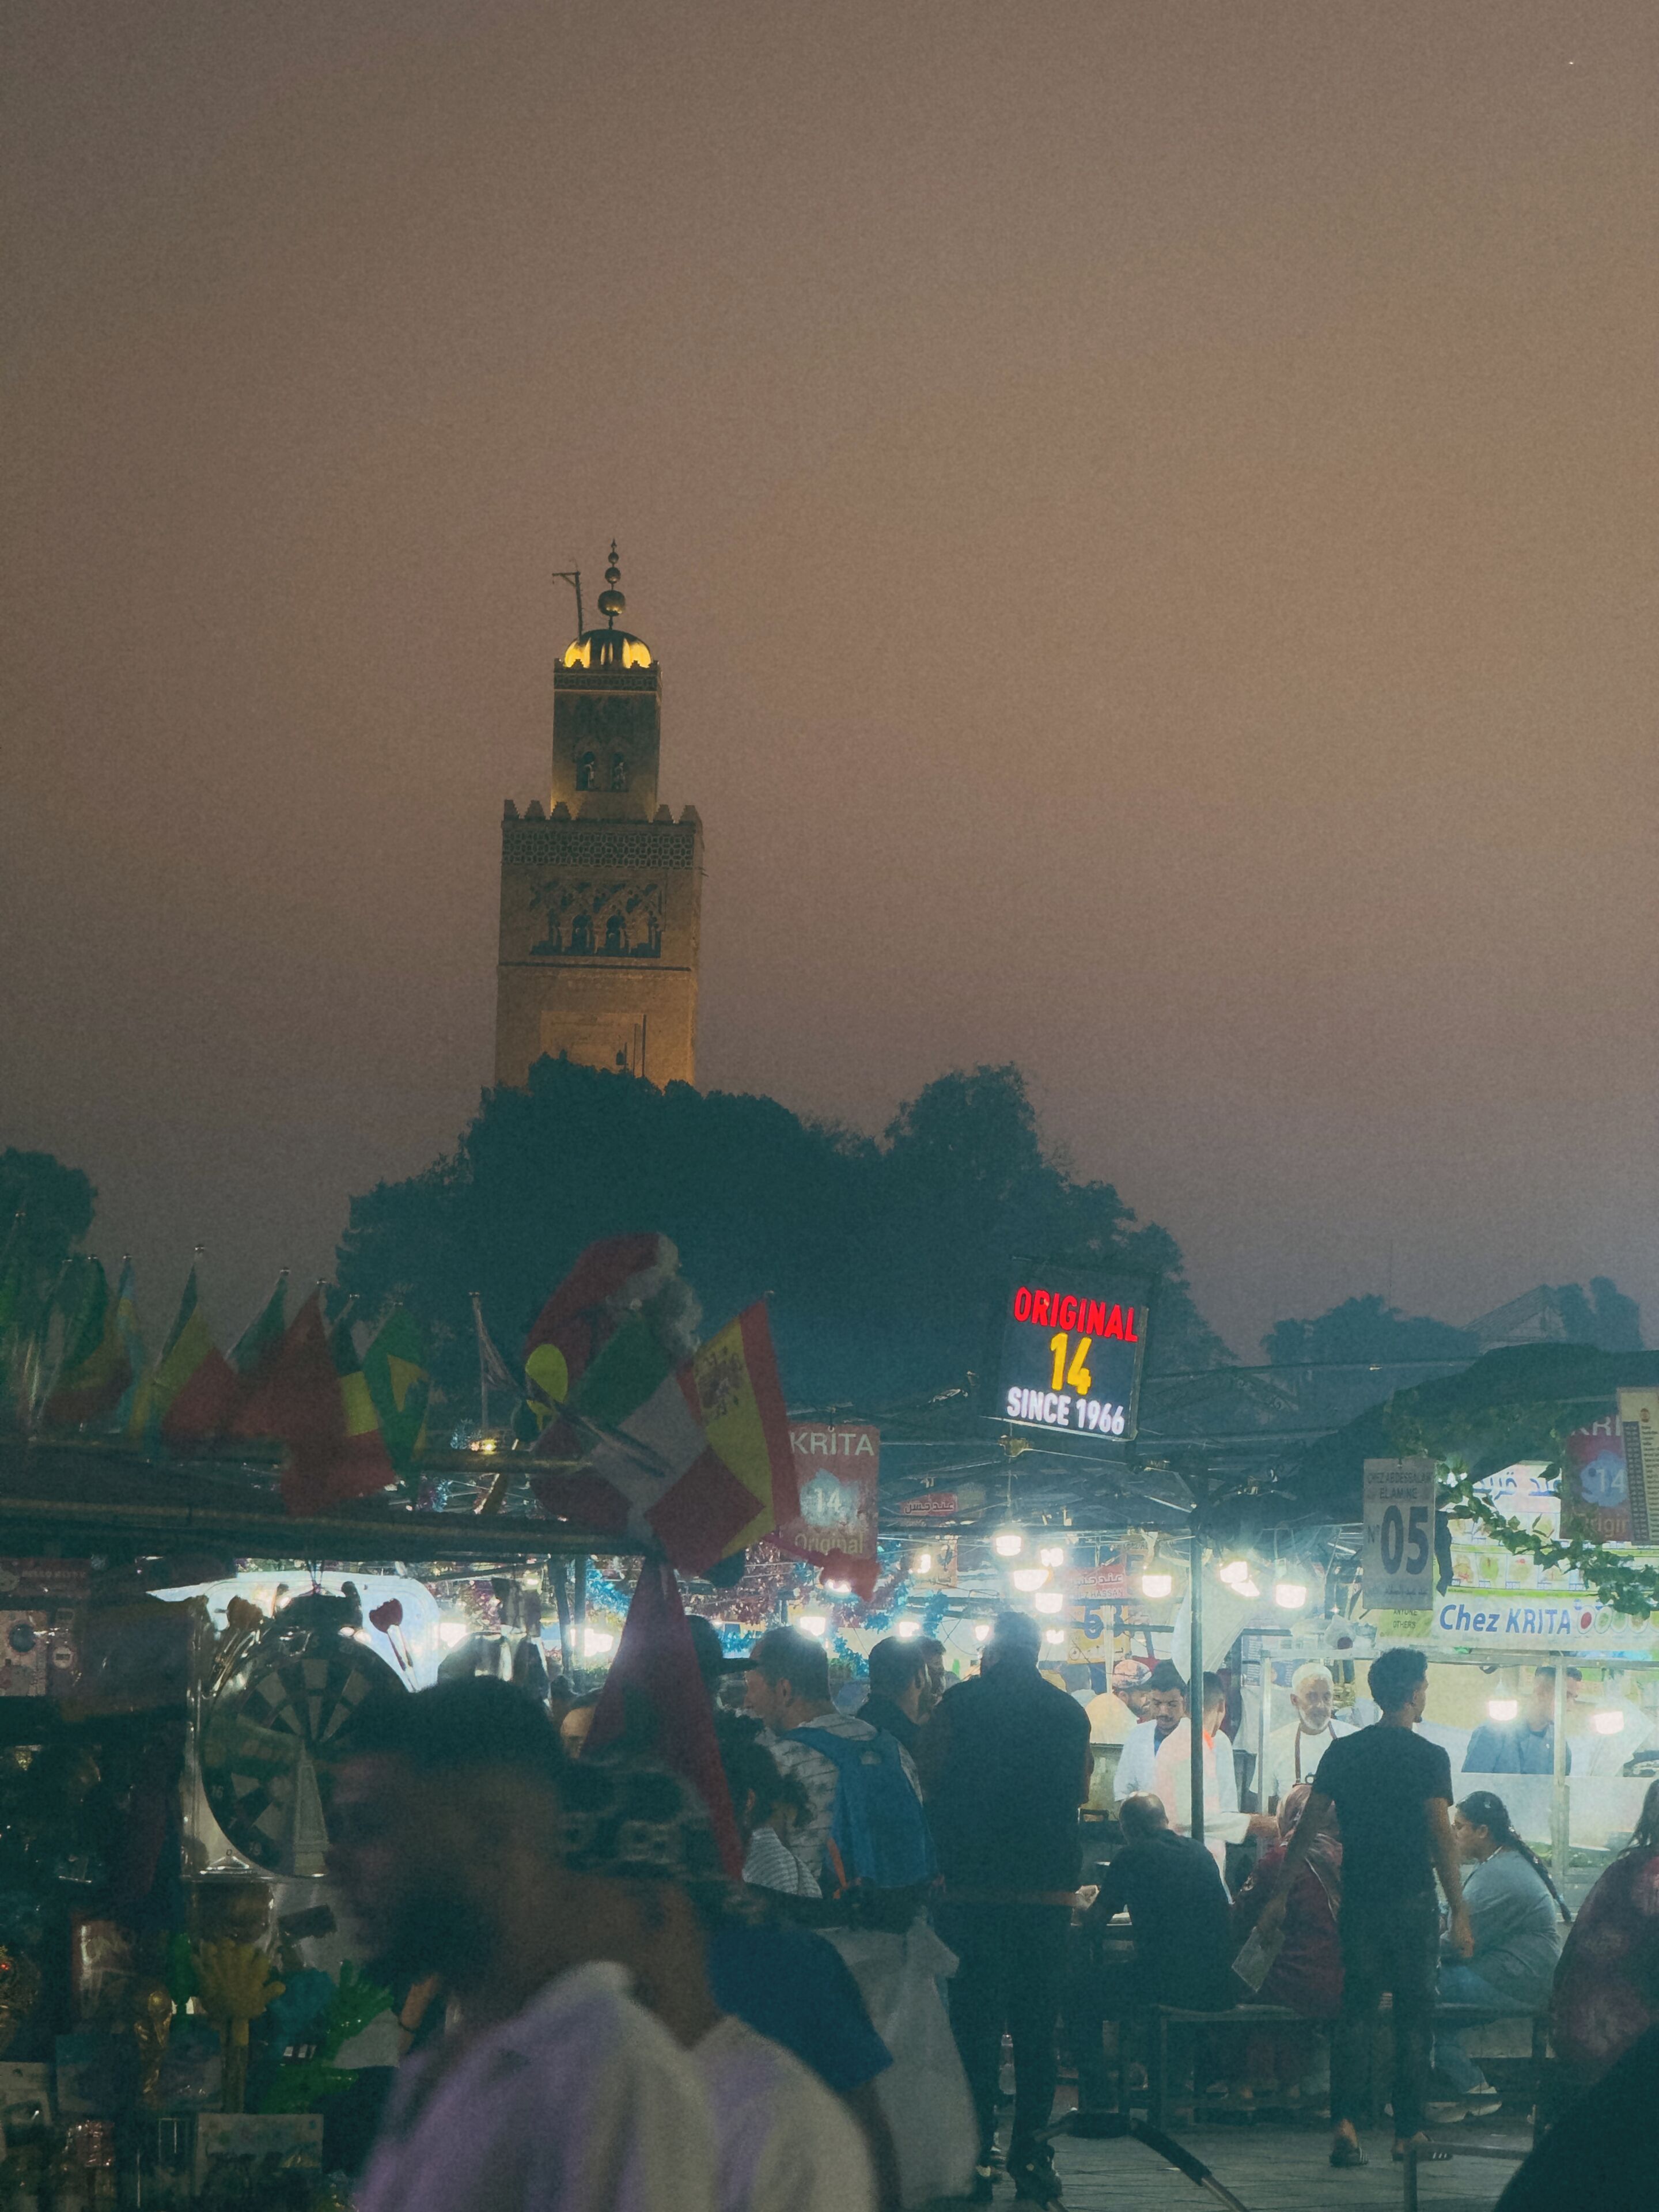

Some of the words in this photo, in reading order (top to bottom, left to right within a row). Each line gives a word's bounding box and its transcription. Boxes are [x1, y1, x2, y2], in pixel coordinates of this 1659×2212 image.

[1014, 1286, 1139, 1342] ORIGINAL
[1050, 1331, 1092, 1396] 14
[1006, 1386, 1071, 1426] SINCE
[1076, 1398, 1125, 1435] 1966
[789, 1431, 876, 1456] KRITA
[1595, 1468, 1627, 1494] 14
[813, 1487, 842, 1513] 14
[795, 1531, 865, 1556] Original
[1380, 1505, 1430, 1575] 05
[1090, 1588, 1124, 1599] HASSAN
[1392, 1620, 1416, 1629] OTHERS
[1440, 1604, 1500, 1632] Chez
[1505, 1608, 1571, 1635] KRITA
